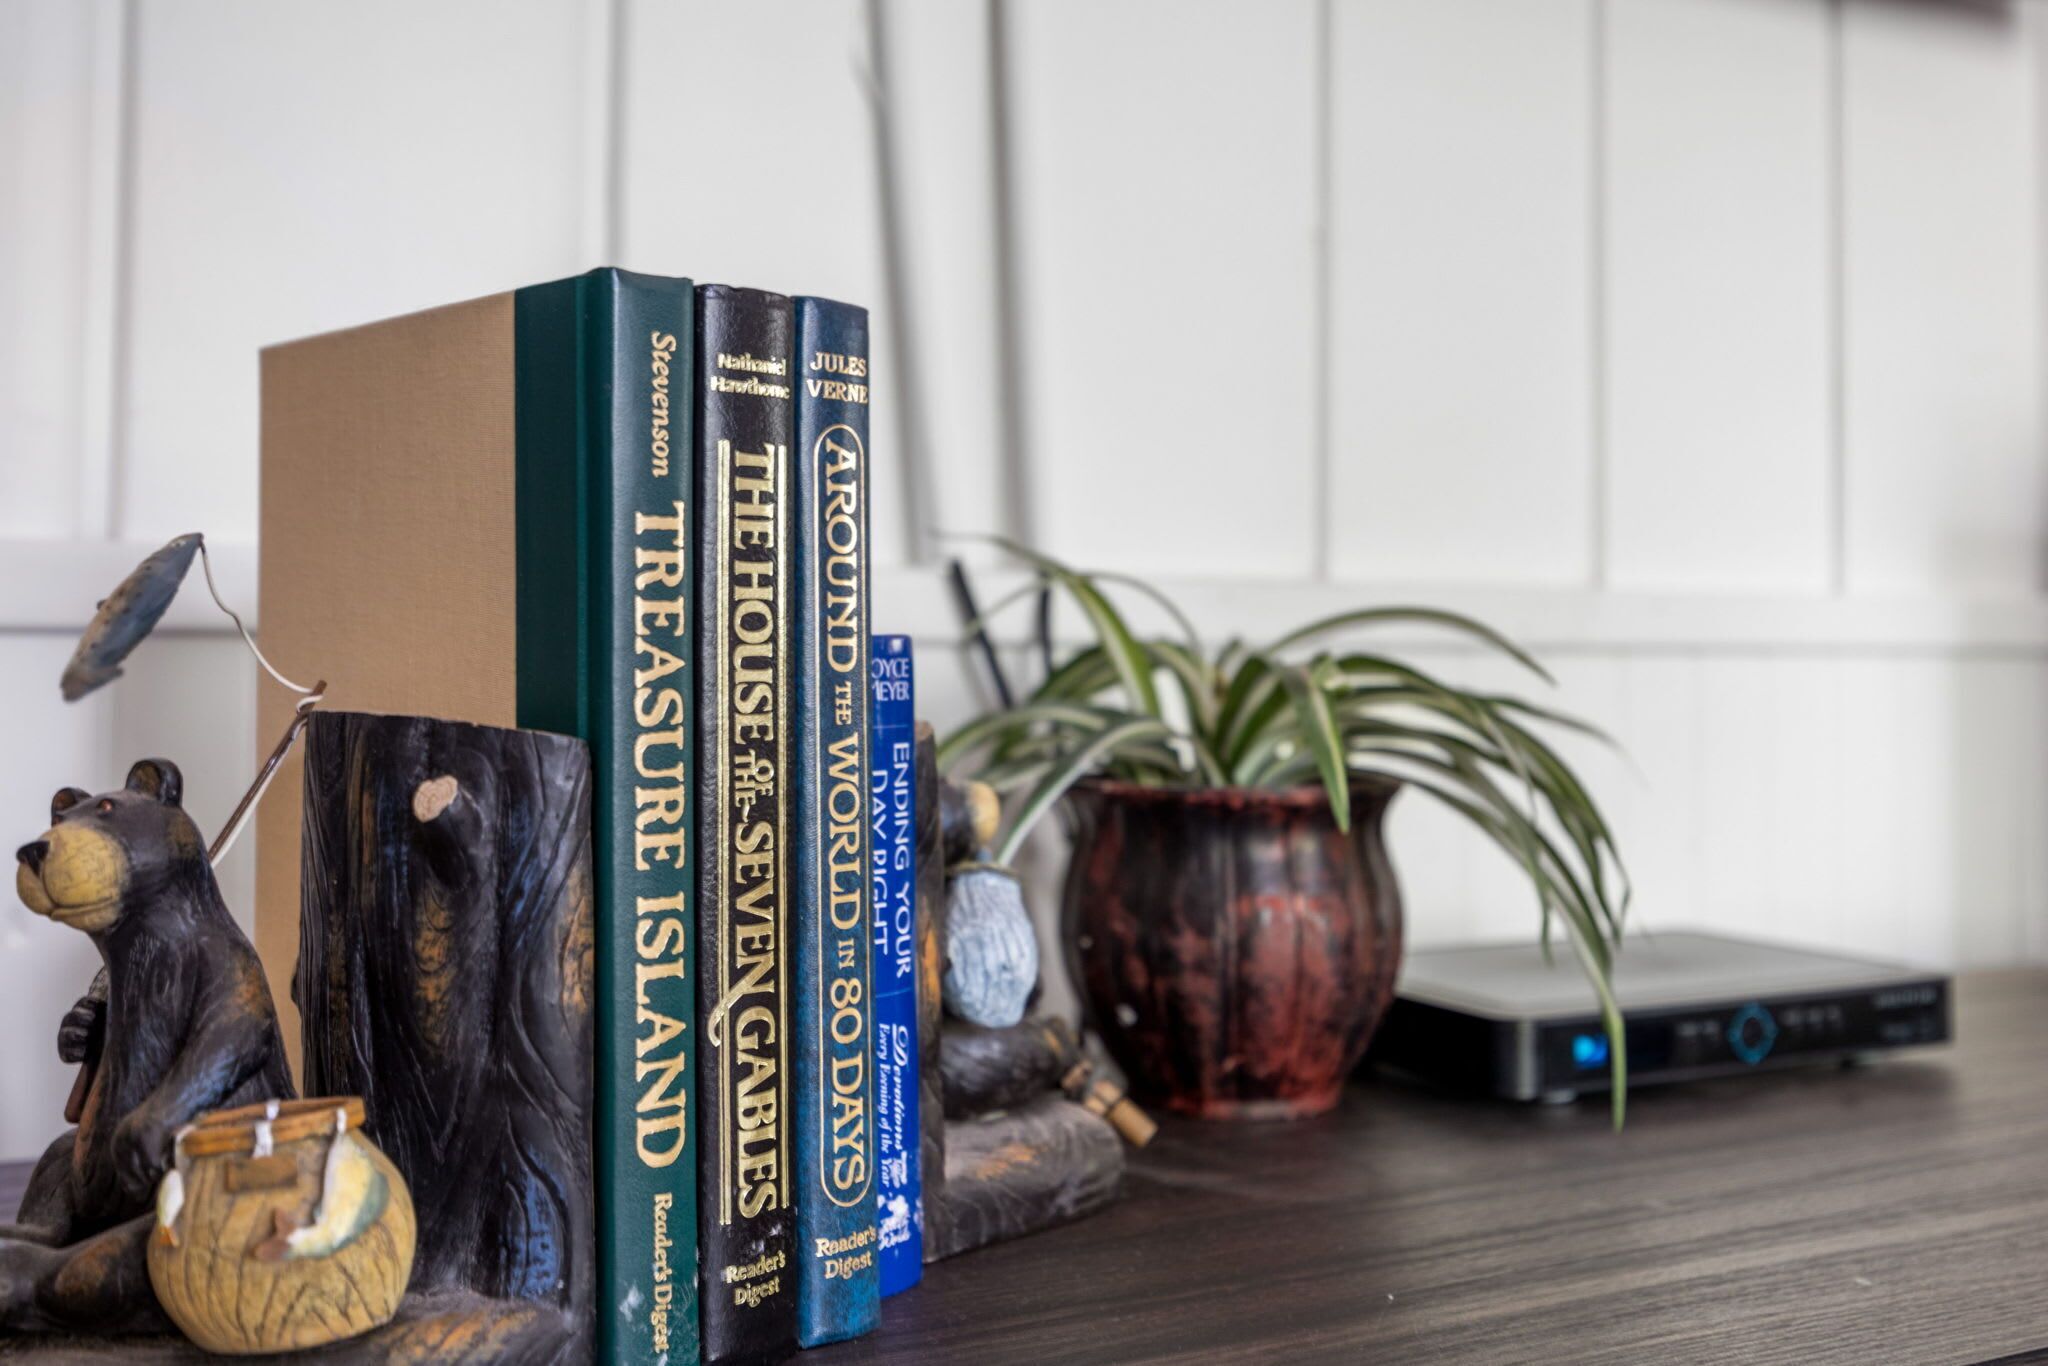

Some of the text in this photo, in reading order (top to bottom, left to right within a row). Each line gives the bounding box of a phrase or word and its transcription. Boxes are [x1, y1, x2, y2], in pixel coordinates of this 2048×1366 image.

[652, 330, 677, 478] Stevenson
[710, 375, 790, 399] Hawthorne
[717, 352, 786, 376] Nathaniel
[807, 378, 868, 404] VERNE
[810, 351, 867, 378] JULES
[734, 443, 775, 549] THE
[733, 559, 775, 745] HOUSE
[871, 657, 909, 679] OYCE
[735, 748, 756, 822] THE
[754, 758, 774, 797] OF
[825, 437, 866, 1190] AROUND THE WORLD IN 80 DAYS
[633, 501, 687, 1168] TREASURE ISLAND
[872, 770, 889, 955] DAY RIGHT
[893, 742, 912, 978] ENDING YOUR
[735, 1005, 777, 1218] GABLES
[877, 1023, 893, 1188] Every Evening of the Year
[892, 1023, 910, 1151] Devotions
[651, 1192, 673, 1353] Reader's Digest
[726, 1250, 786, 1284] Reader's
[815, 1225, 877, 1258] Reader's
[824, 1250, 872, 1280] Digest
[735, 1276, 780, 1308] Digest
